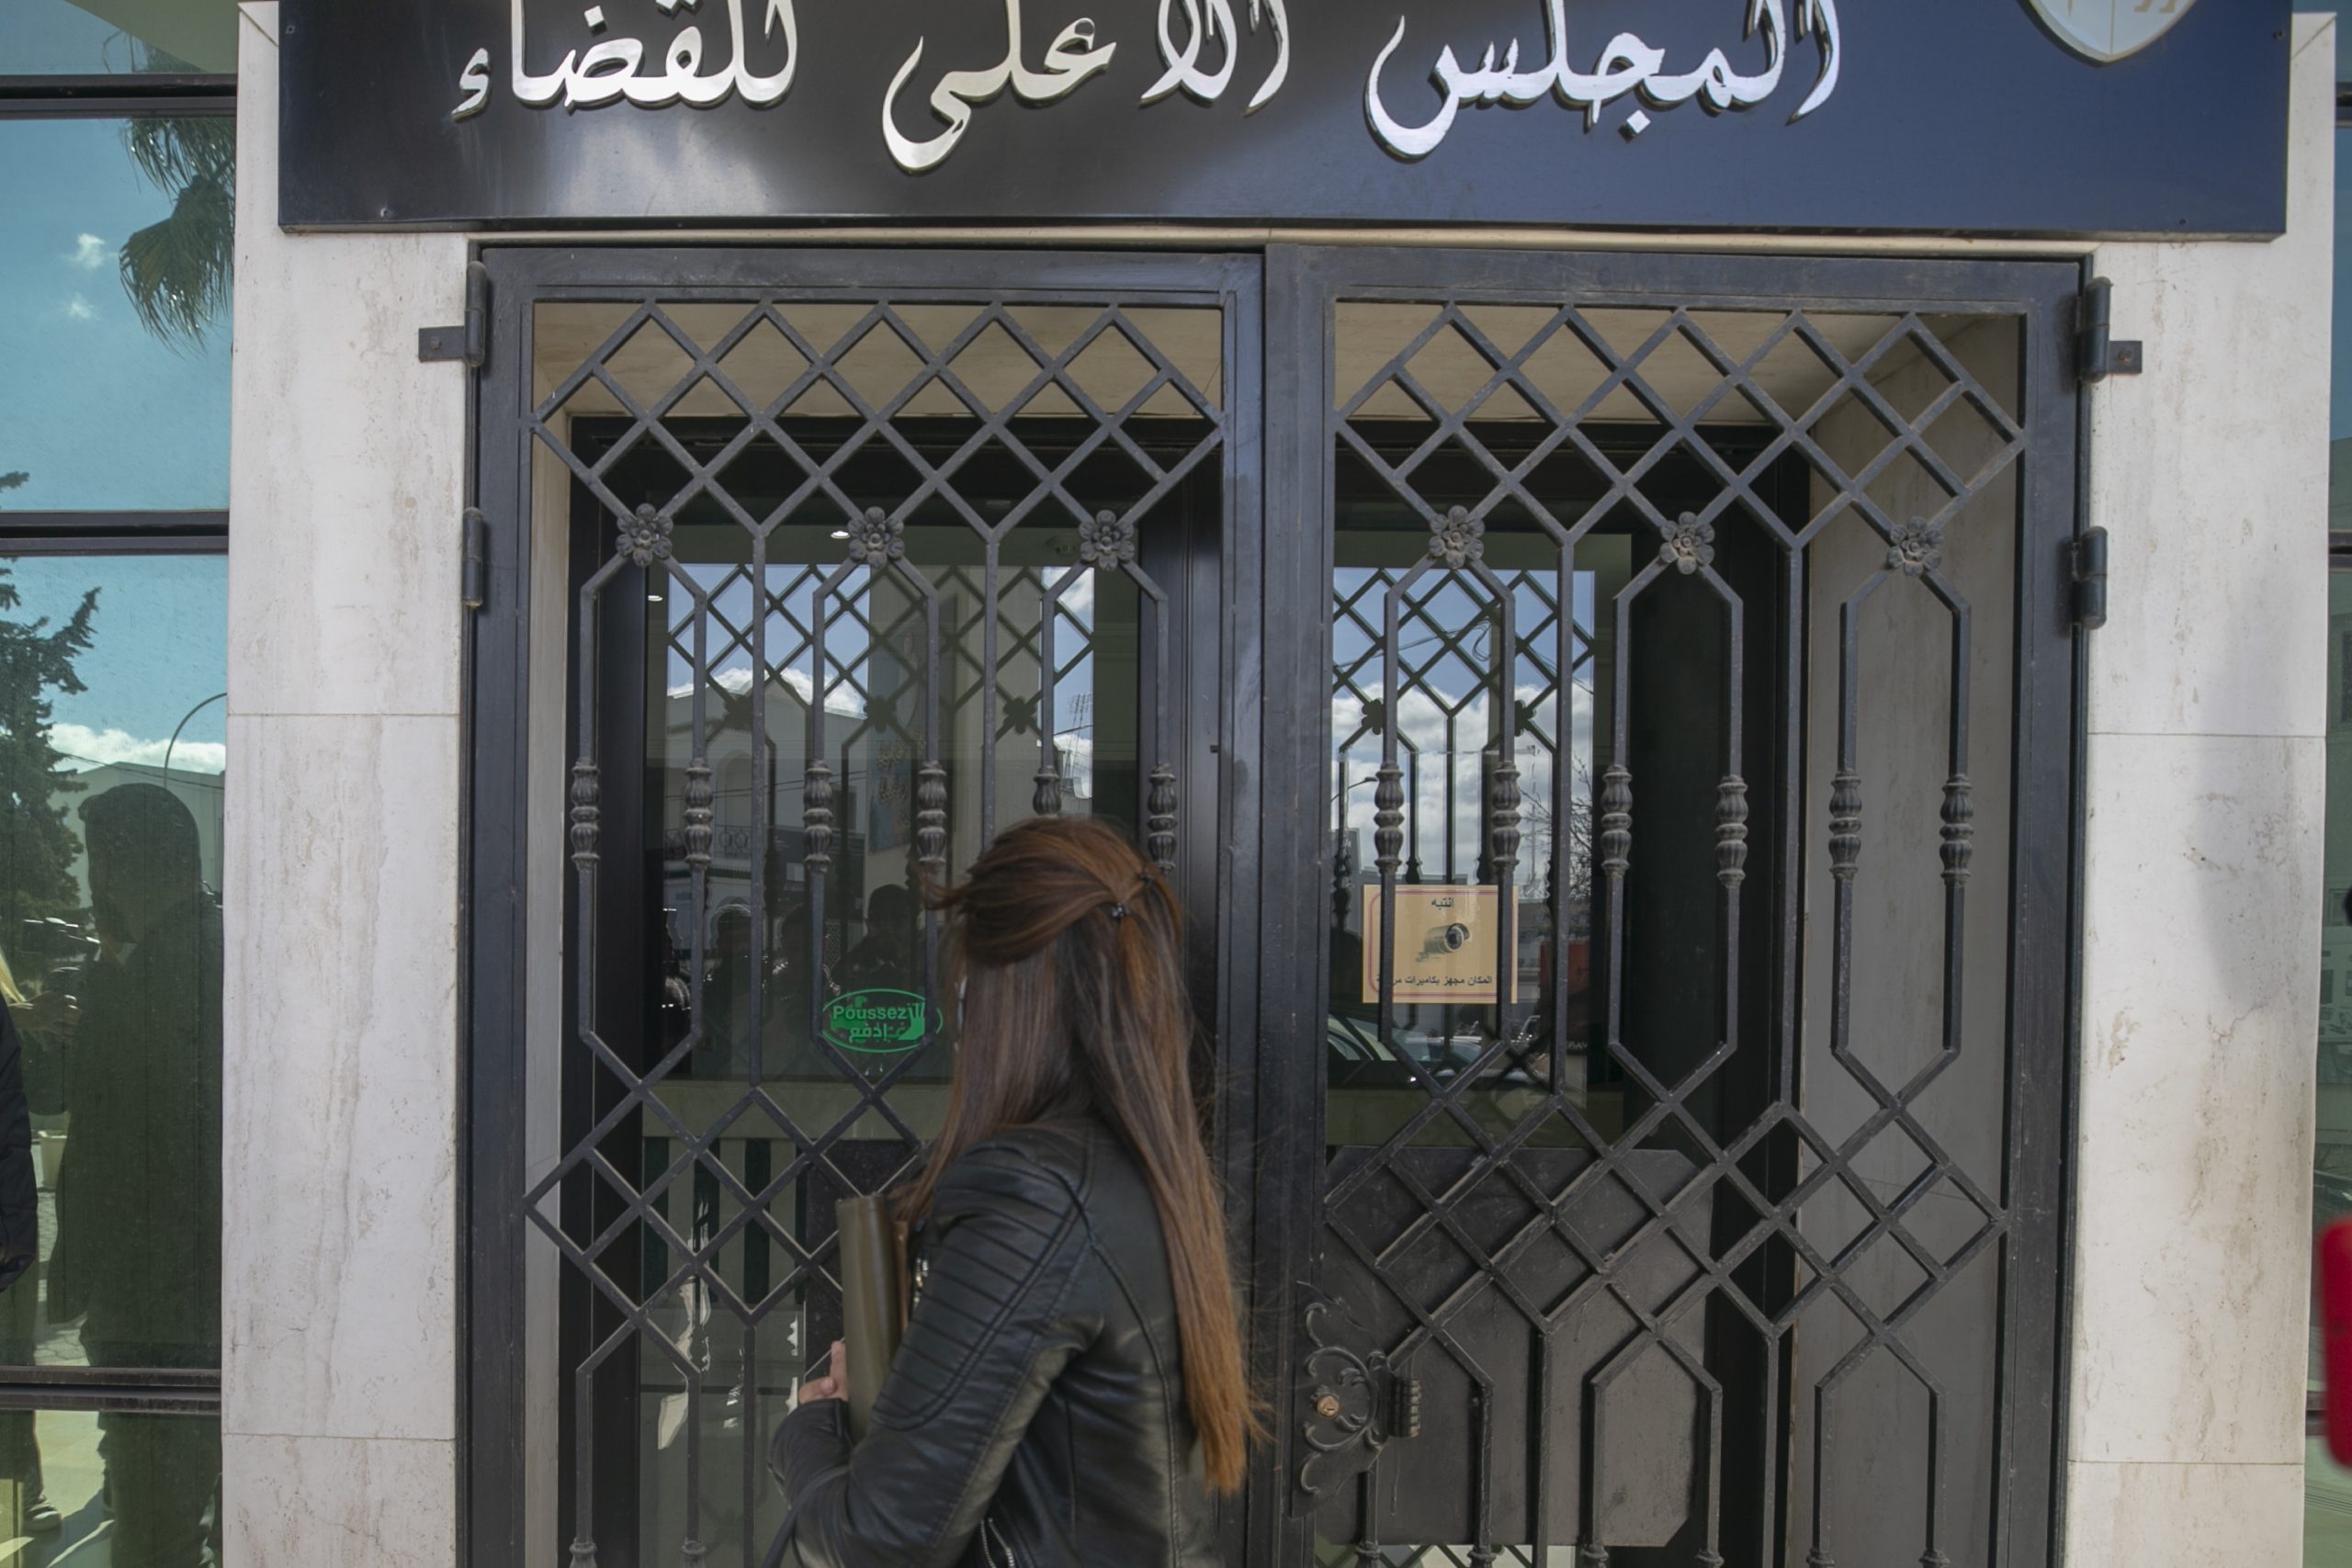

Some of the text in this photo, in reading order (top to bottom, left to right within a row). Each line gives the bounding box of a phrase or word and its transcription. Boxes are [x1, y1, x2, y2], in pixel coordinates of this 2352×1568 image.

[451, 0, 797, 118] للقضاء
[1364, 0, 1841, 162] المجلس
[1430, 897, 1454, 909] انتبه
[1443, 975, 1464, 987] مجهز
[1467, 975, 1492, 986] المكان
[832, 1005, 908, 1021] Poussez
